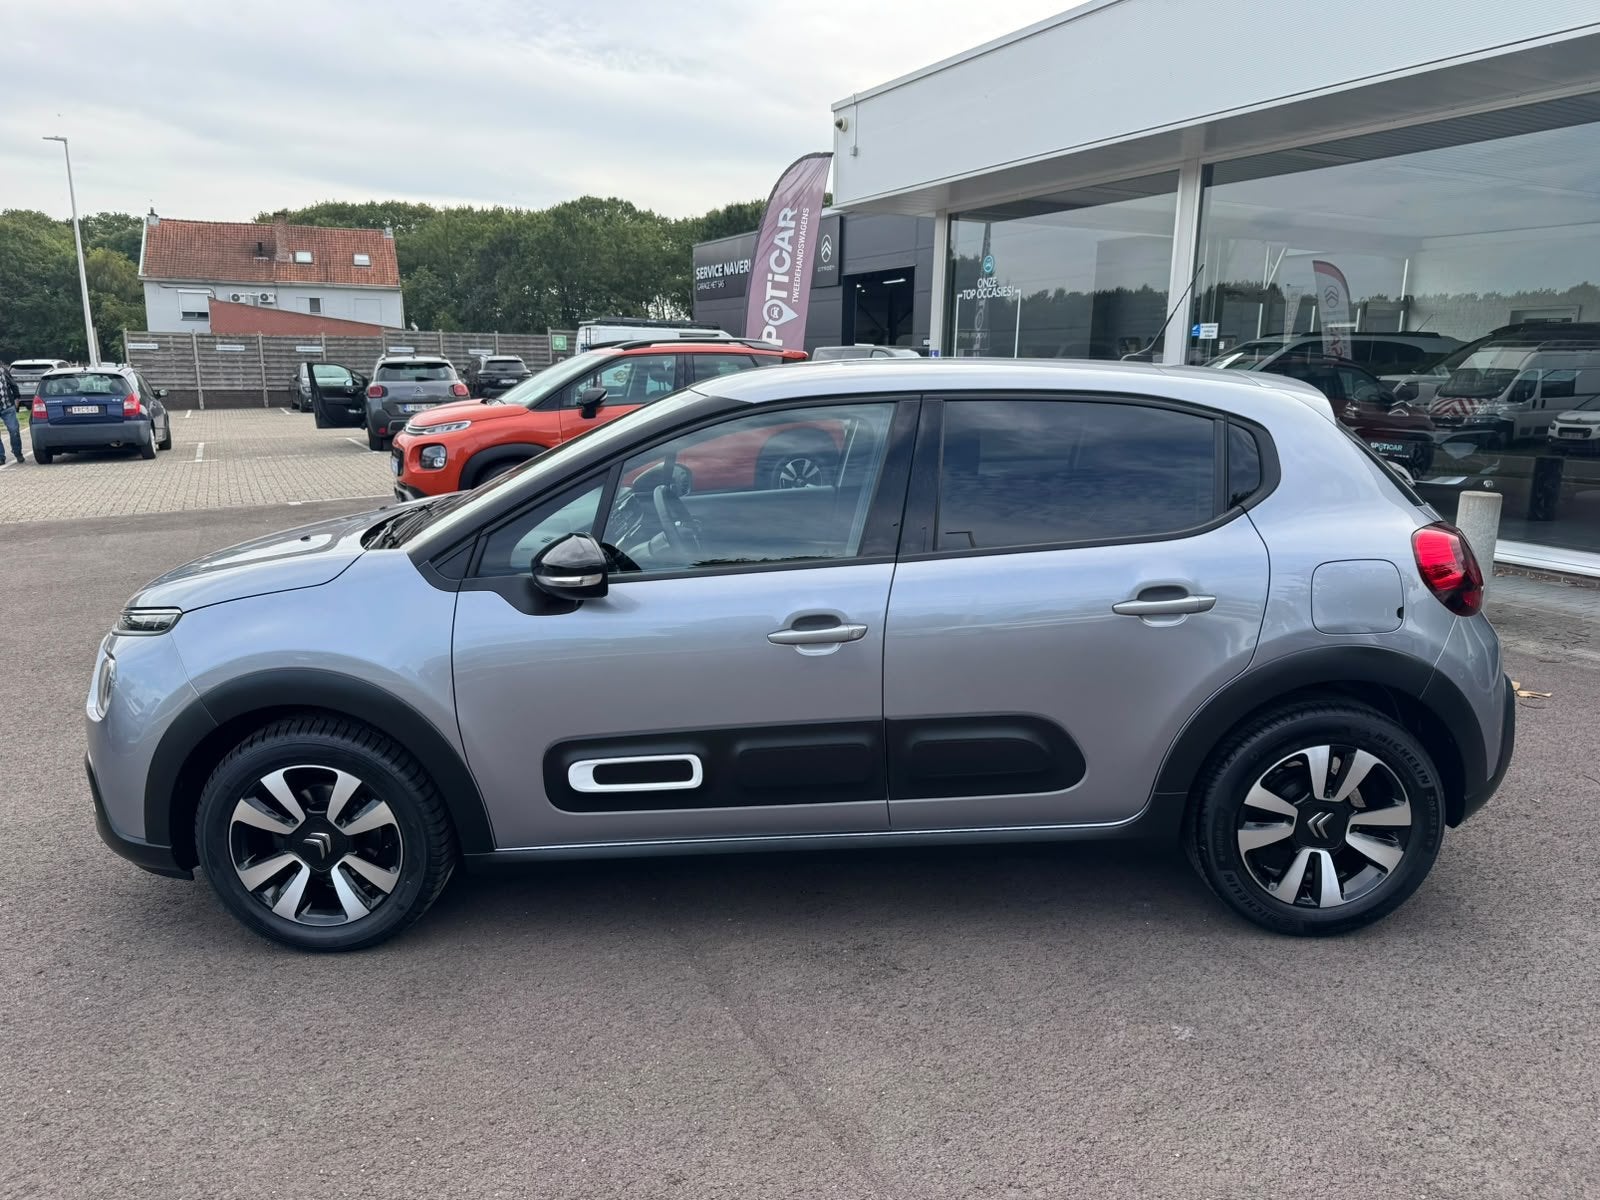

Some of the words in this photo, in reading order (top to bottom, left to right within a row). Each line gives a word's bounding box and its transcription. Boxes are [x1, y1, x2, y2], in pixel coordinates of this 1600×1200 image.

[696, 264, 723, 280] SERVICE
[792, 207, 810, 304] TWEEDEHANDSWAGENS
[762, 207, 799, 346] POTiCAR
[962, 289, 977, 300] TOP
[976, 286, 1015, 299] OCCASIES!
[977, 277, 998, 288] ONZE
[1375, 731, 1430, 784] MICHELIN
